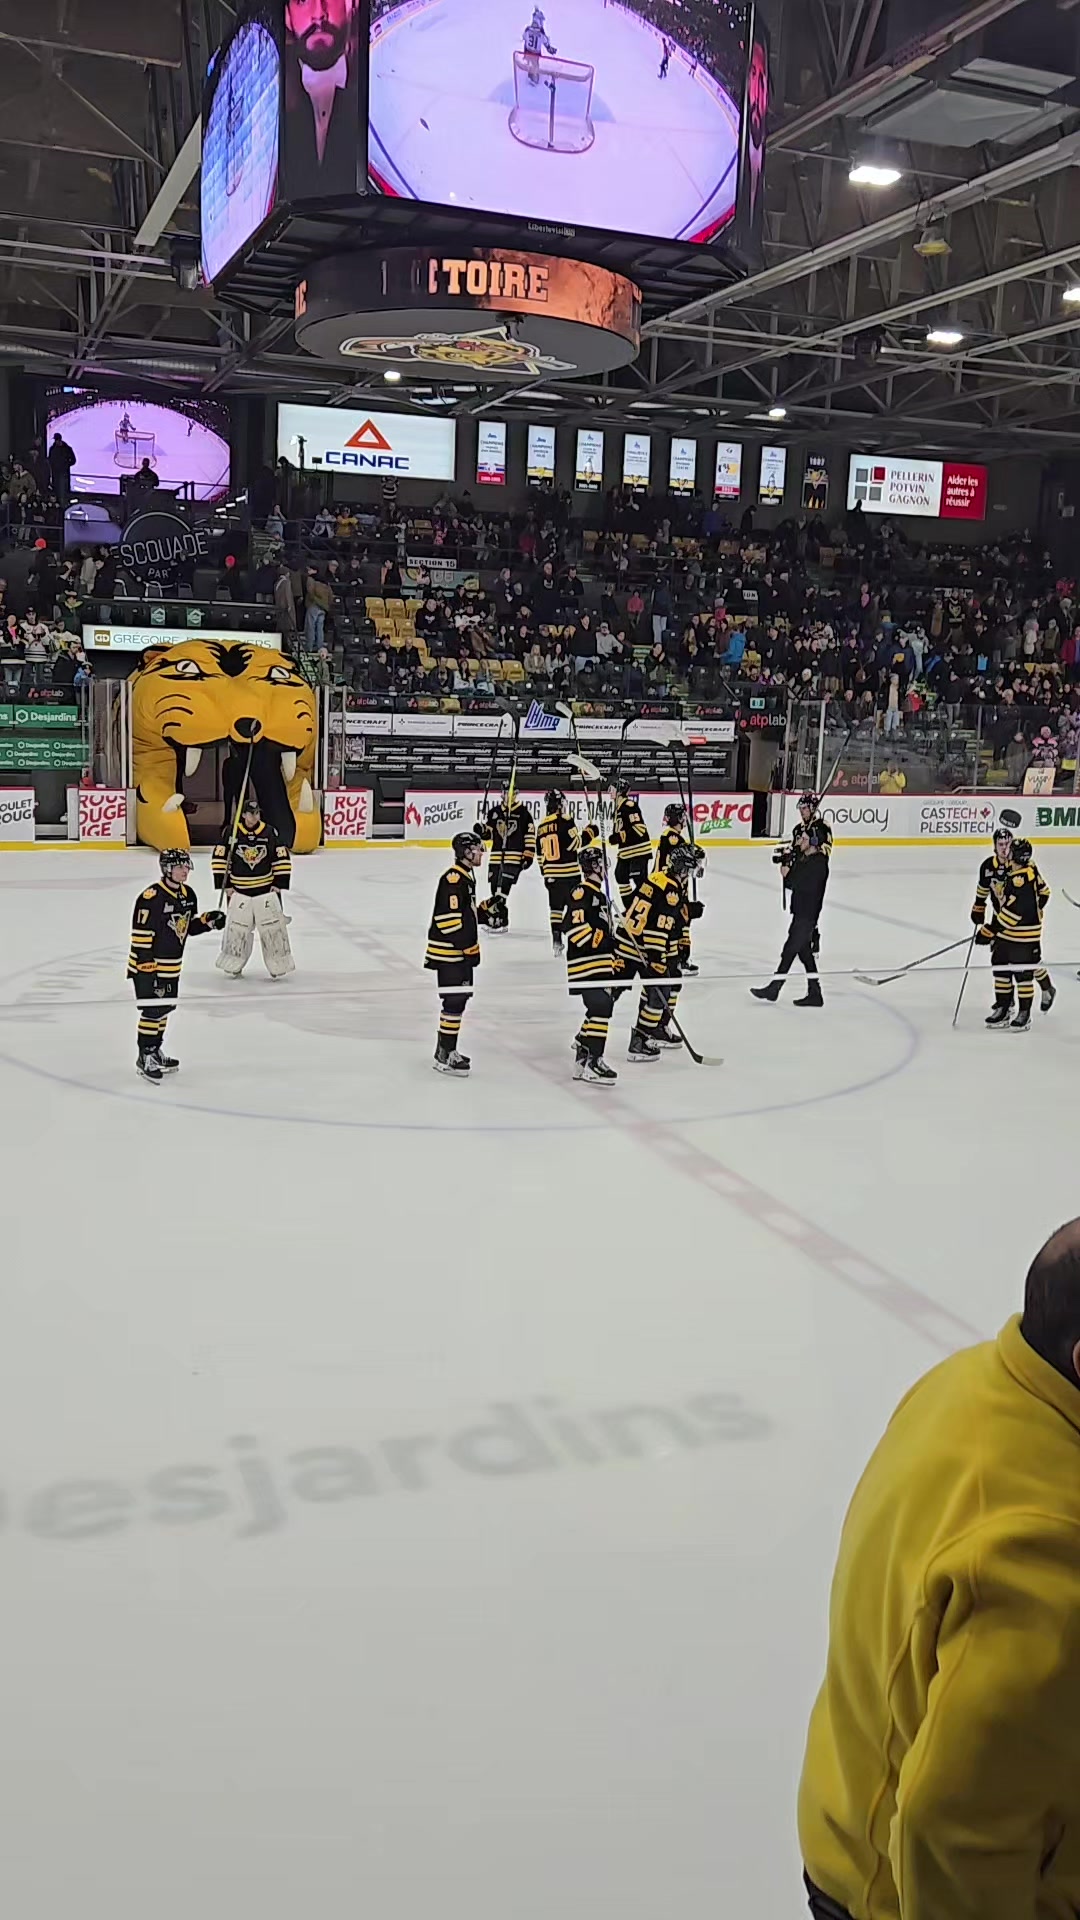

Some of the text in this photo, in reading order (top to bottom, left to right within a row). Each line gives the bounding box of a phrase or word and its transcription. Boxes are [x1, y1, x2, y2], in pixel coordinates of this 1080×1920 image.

[326, 451, 409, 470] CANAC
[891, 470, 934, 482] PELLERIN
[947, 475, 979, 486] Aider les
[889, 482, 926, 493] POTVIN
[947, 488, 969, 497] autres
[889, 495, 930, 506] GAGNON
[946, 498, 971, 507] réussir
[31, 711, 77, 723] Desjardins
[750, 713, 787, 728] atplab
[424, 801, 458, 814] POULET
[921, 807, 977, 819] CASTECH
[424, 809, 463, 826] ROUGE
[1036, 807, 1080, 827] BM
[702, 820, 726, 831] PLUS
[920, 821, 995, 834] PLESSITECH
[137, 909, 149, 925] 17
[571, 908, 585, 924] 21
[0, 1391, 775, 1541] esjardins
